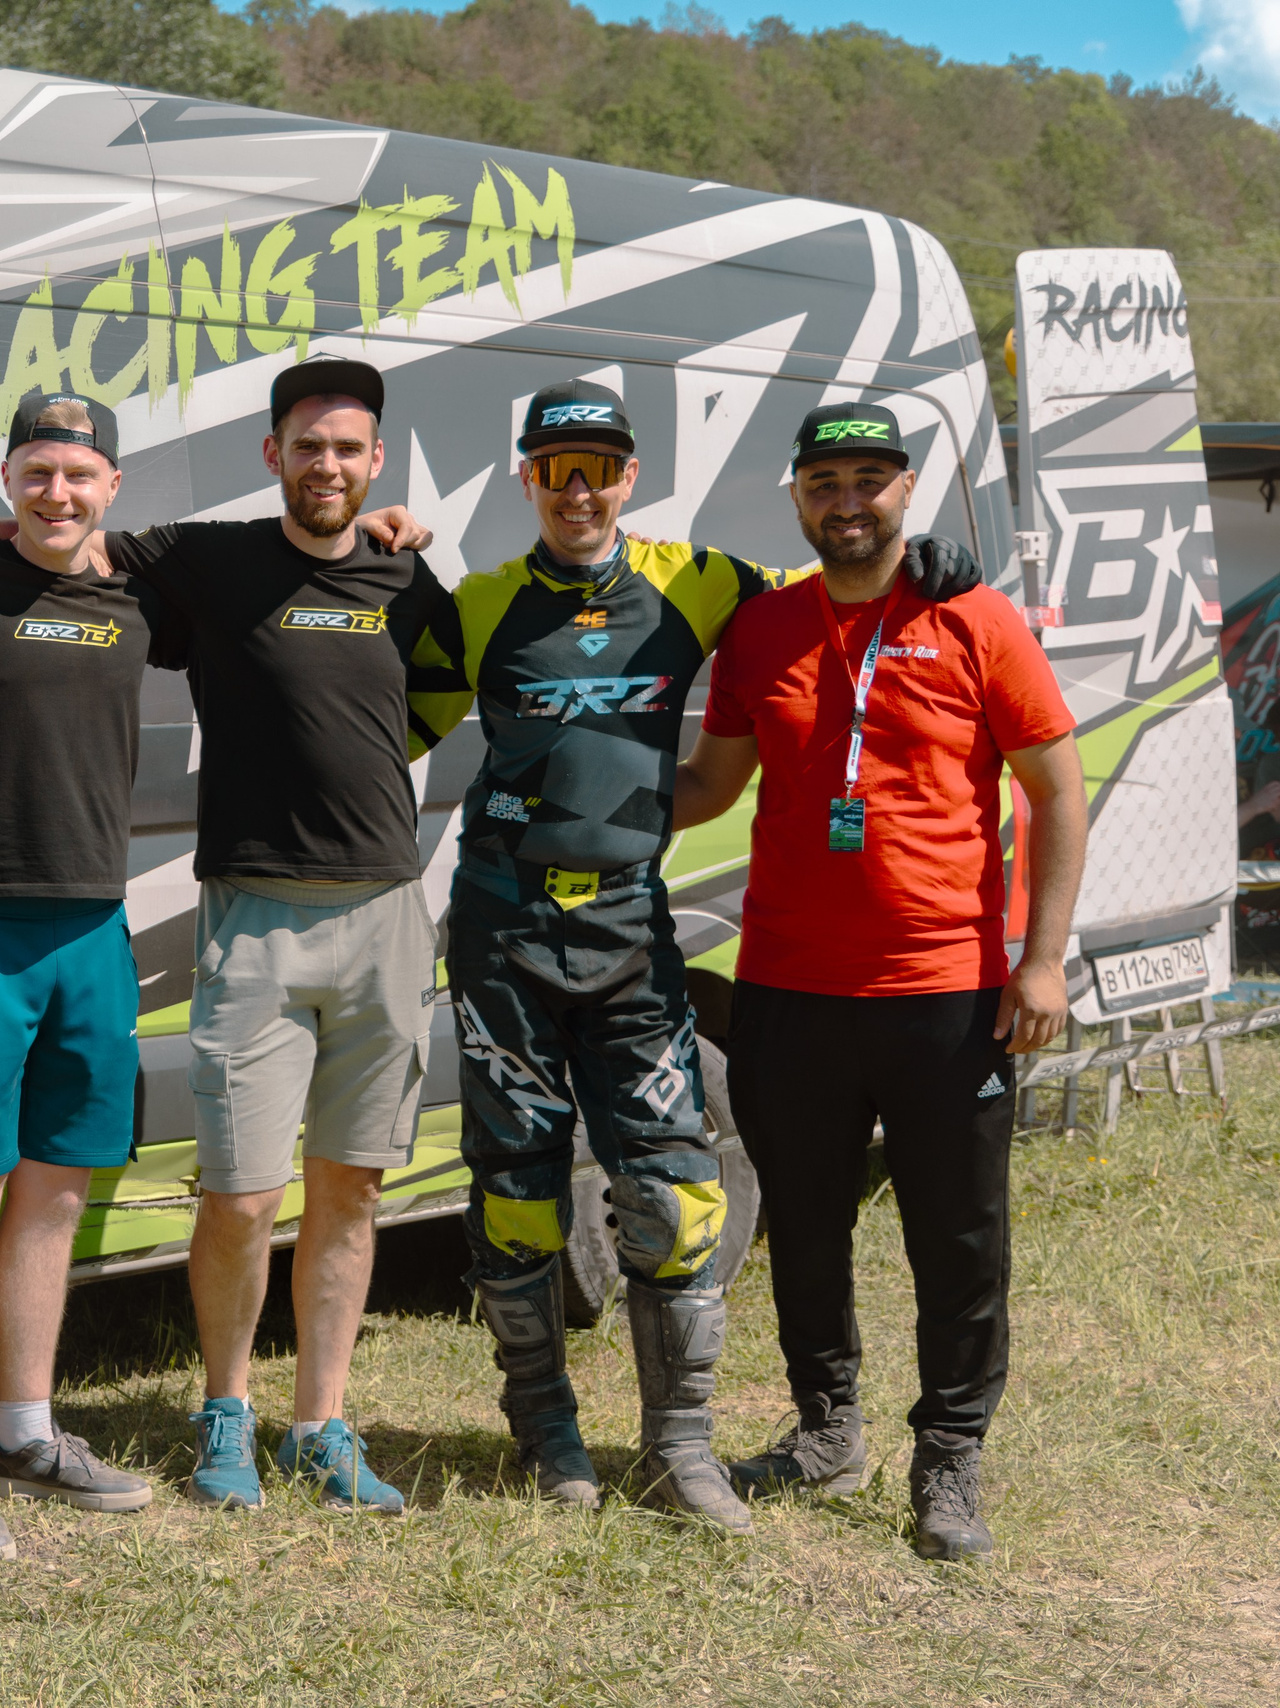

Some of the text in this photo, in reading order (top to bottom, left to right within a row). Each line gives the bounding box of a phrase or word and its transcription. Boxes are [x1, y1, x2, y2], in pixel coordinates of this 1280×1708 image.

[329, 158, 576, 346] TEAM
[541, 405, 612, 426] BRZ
[814, 420, 890, 442] BRZ
[291, 612, 349, 627] BRZ
[25, 623, 79, 639] BRZ
[515, 676, 674, 724] BRZ
[486, 801, 525, 814] RIDE
[492, 790, 523, 805] bike
[486, 809, 530, 823] ZONE
[1172, 942, 1201, 968] 790
[454, 990, 572, 1133] BRZ
[631, 1003, 697, 1121] BR
[977, 1085, 1006, 1098] adidas
